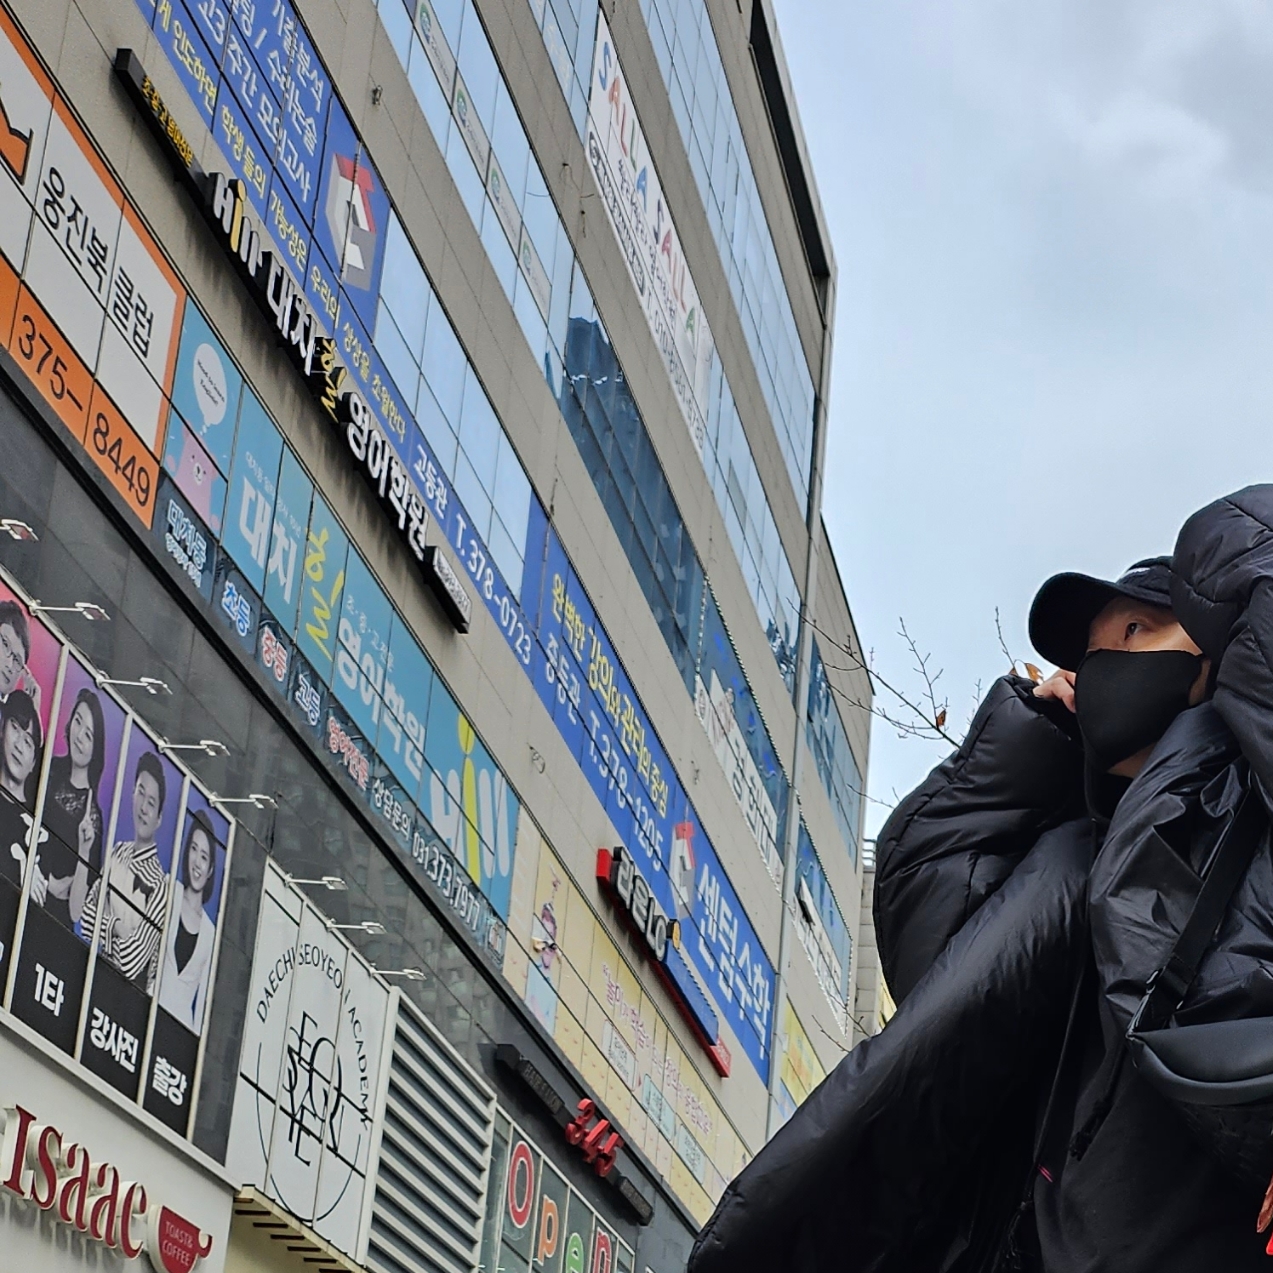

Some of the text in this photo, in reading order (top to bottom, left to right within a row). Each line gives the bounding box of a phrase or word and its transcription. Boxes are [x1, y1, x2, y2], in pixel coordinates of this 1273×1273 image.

[228, 35, 258, 108] 주간
[257, 93, 311, 202] 모의고사
[598, 41, 647, 212] SALLA
[654, 199, 697, 338] SALLA
[173, 21, 217, 116] 인도하면
[221, 105, 266, 199] 학생들의
[271, 190, 307, 273] 가능성은
[311, 265, 340, 328] 우리의
[343, 322, 371, 383] 상상을
[372, 374, 406, 443] 초월한다
[414, 444, 448, 520] 고등관
[17, 315, 151, 502] 375-8449
[348, 392, 430, 561] 영어학원
[337, 617, 428, 781] 영어학원
[545, 632, 581, 725] 중등관
[552, 573, 586, 662] 완벽한
[222, 581, 251, 637] 초등
[261, 627, 288, 681] 중등
[296, 674, 321, 726] 고등
[373, 779, 411, 832] 상담문의
[35, 963, 65, 1017] 1타
[89, 1006, 140, 1074] 강사진
[256, 946, 297, 1024] DAECHI
[348, 1006, 372, 1131] ACADEMY
[698, 863, 771, 1060] 센텀수학
[152, 1054, 188, 1106] 출강
[3, 1104, 148, 1260] Isaac
[162, 1242, 191, 1268] COFFEE
